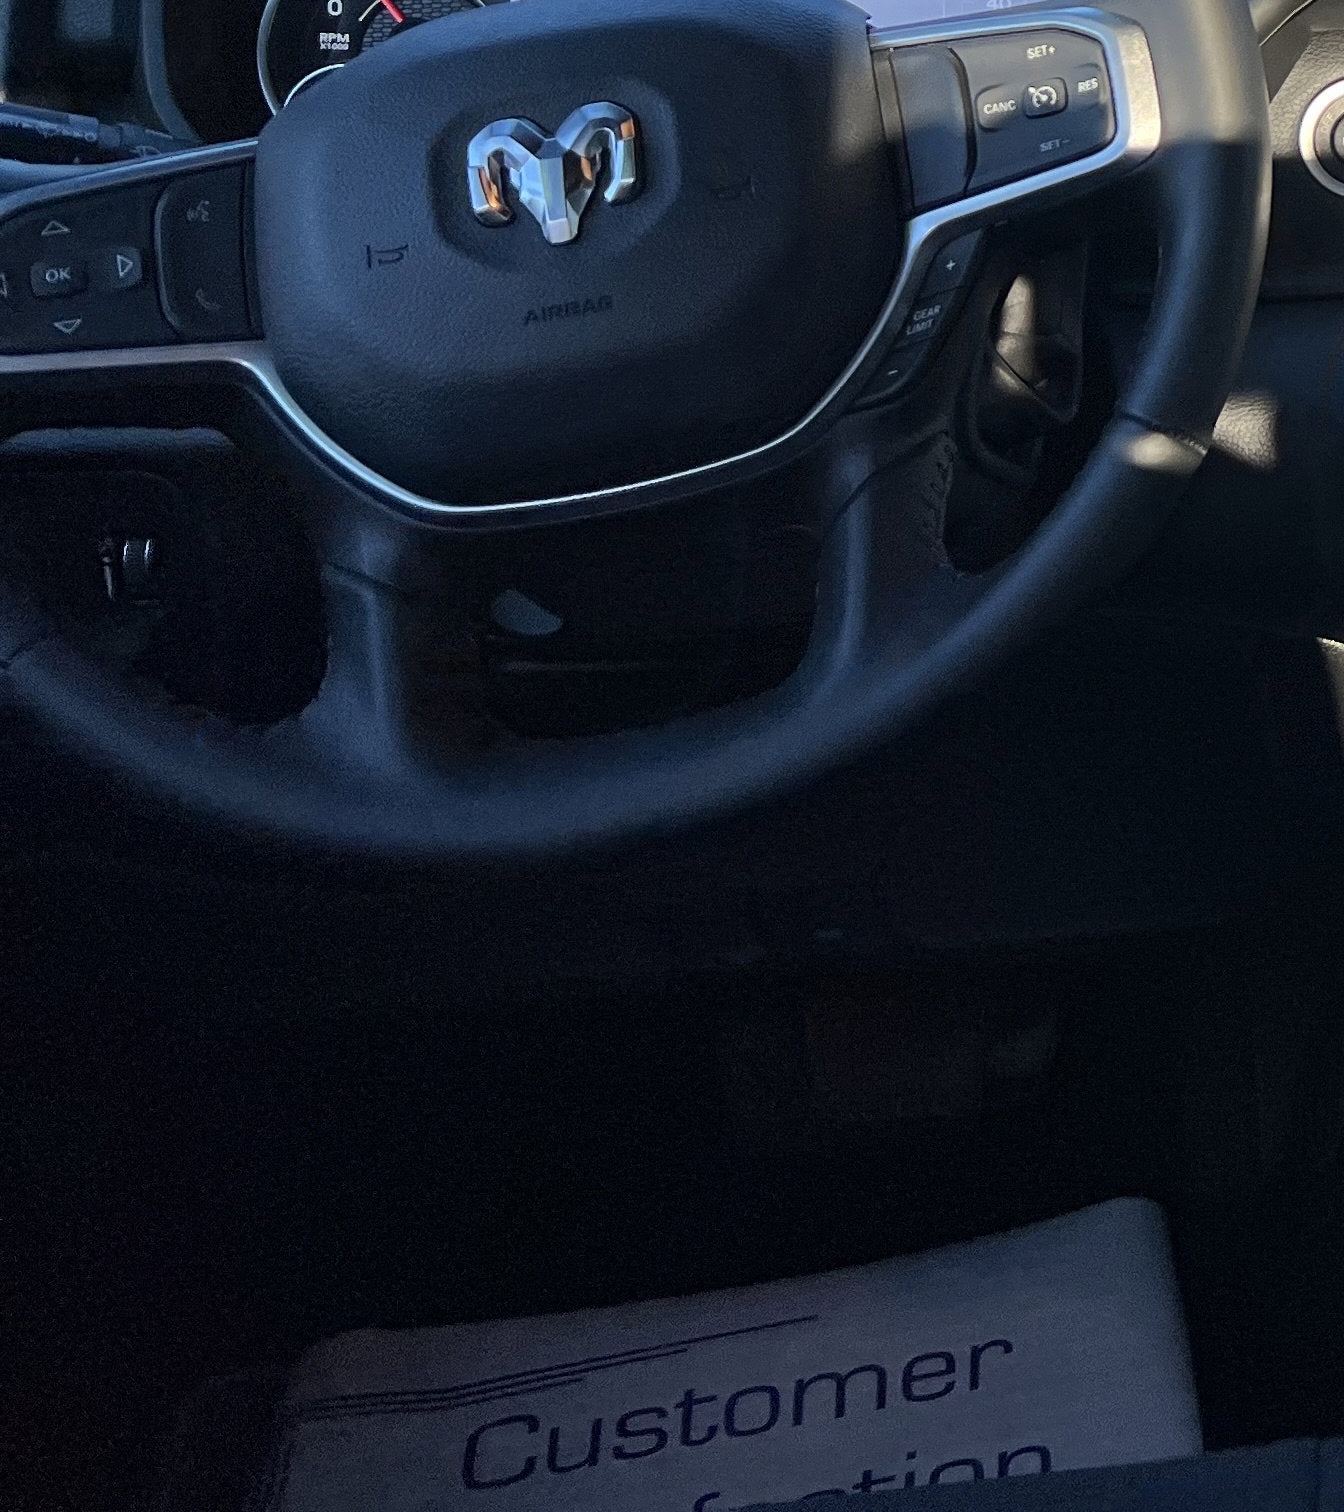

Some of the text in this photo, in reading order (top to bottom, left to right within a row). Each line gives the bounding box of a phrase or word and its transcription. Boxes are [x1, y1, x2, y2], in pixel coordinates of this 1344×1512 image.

[319, 32, 350, 43] RPM
[1077, 78, 1099, 92] RES
[983, 100, 1016, 115] CANC
[45, 267, 71, 283] OK
[913, 304, 942, 322] GEAR
[907, 318, 934, 336] LIMIT
[462, 1337, 1015, 1491] Customer
